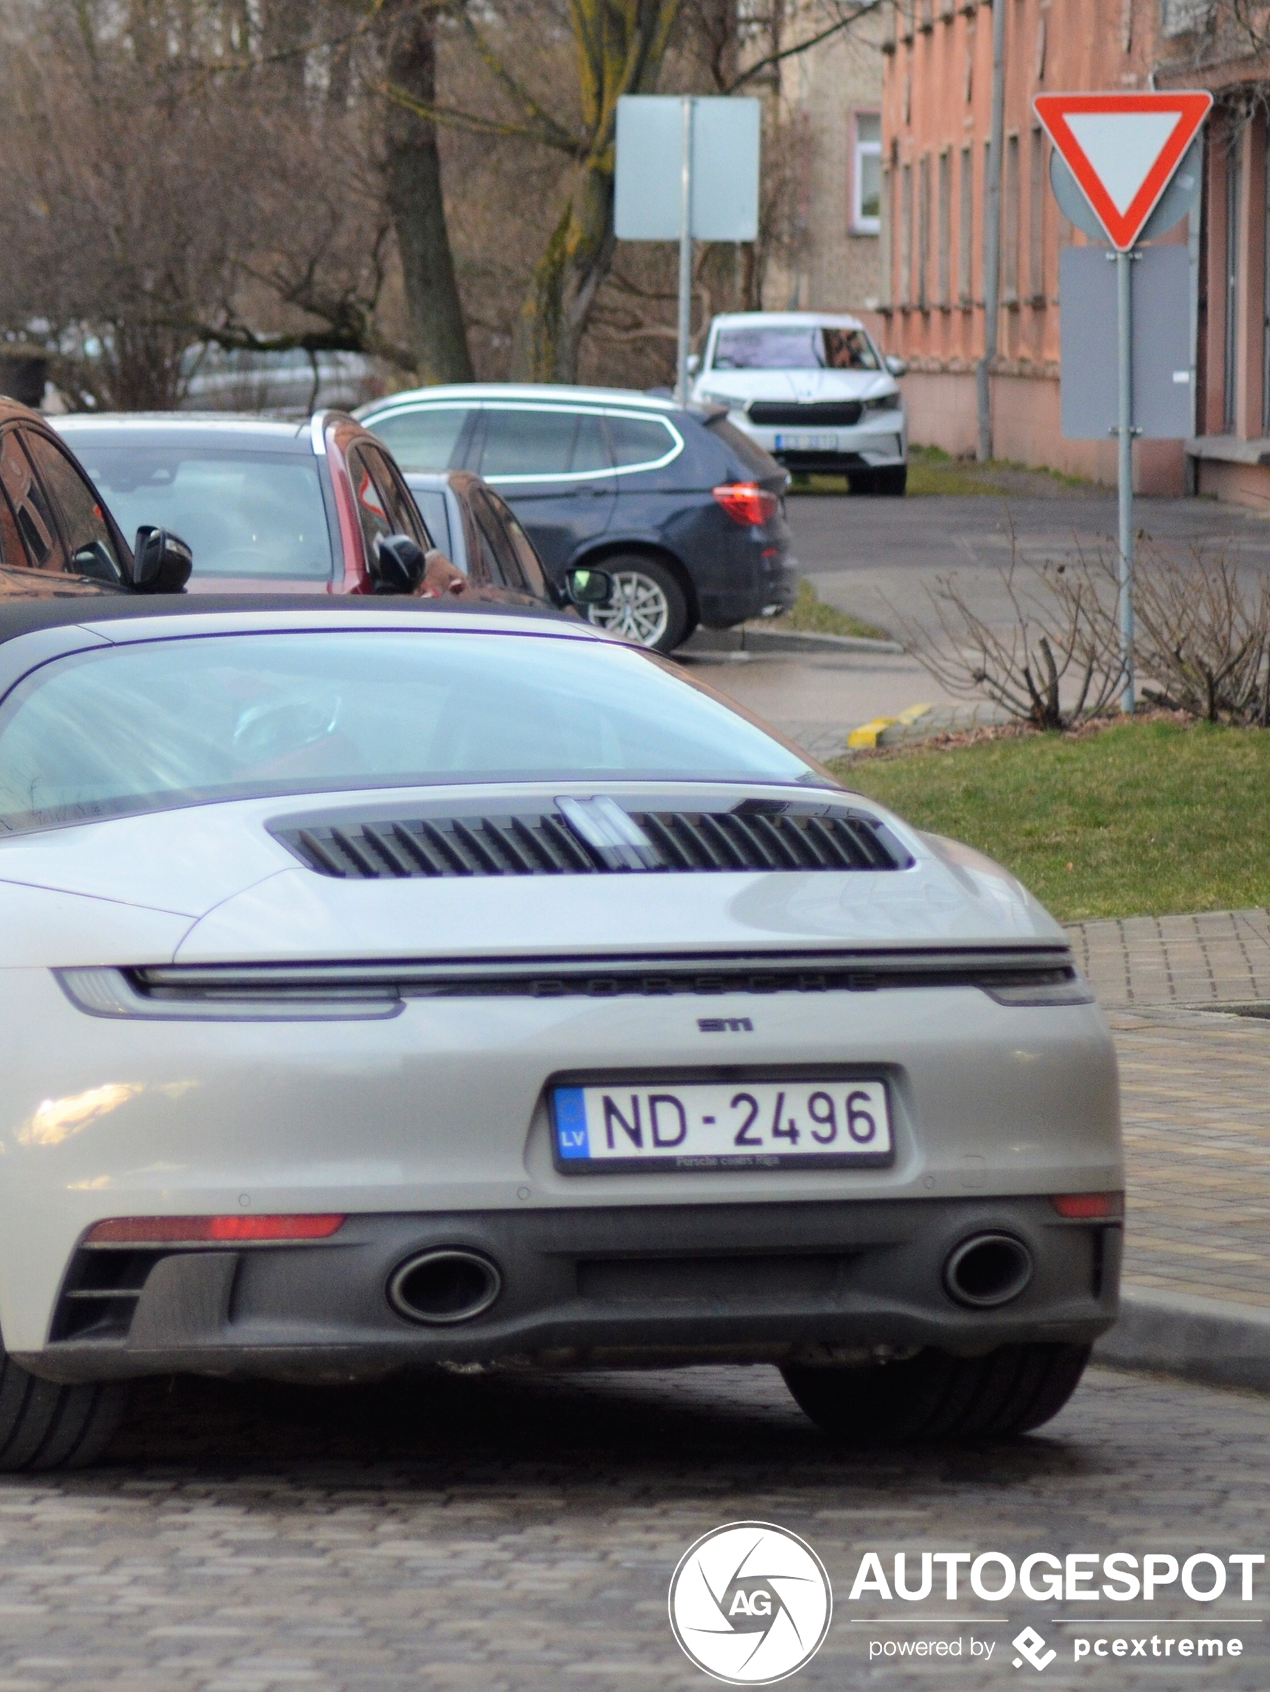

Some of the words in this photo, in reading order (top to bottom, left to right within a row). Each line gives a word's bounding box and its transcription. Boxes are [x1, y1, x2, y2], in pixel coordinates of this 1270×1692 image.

[533, 974, 880, 998] PORSCHE
[697, 1017, 754, 1032] 911
[602, 1090, 877, 1149] ND-2496
[561, 1131, 584, 1147] LV
